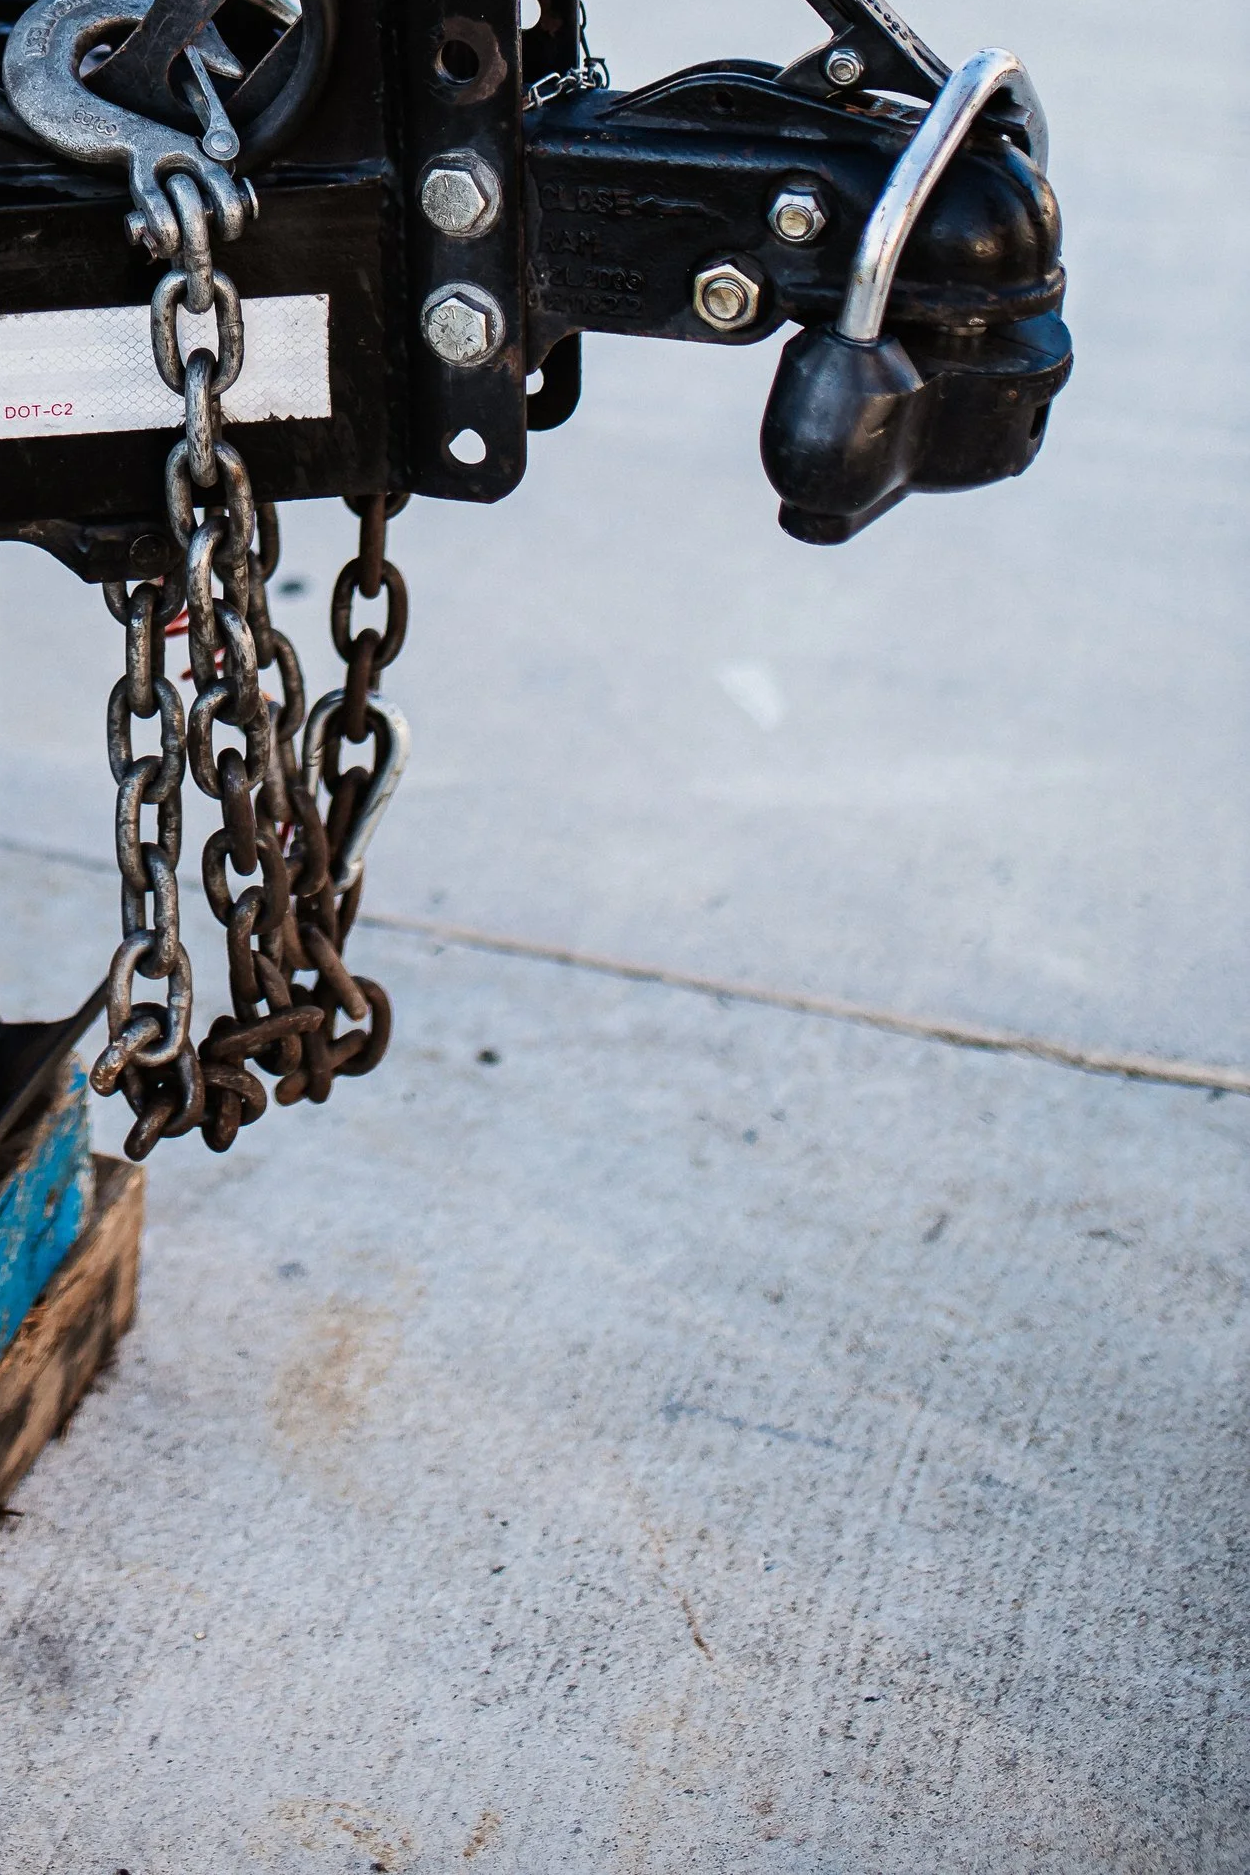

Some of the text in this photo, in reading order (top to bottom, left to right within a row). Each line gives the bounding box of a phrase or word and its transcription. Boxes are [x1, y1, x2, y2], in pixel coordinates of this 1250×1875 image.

[540, 183, 633, 216] CLOSE
[542, 228, 598, 255] RAM
[5, 403, 73, 420] DOT-C2
